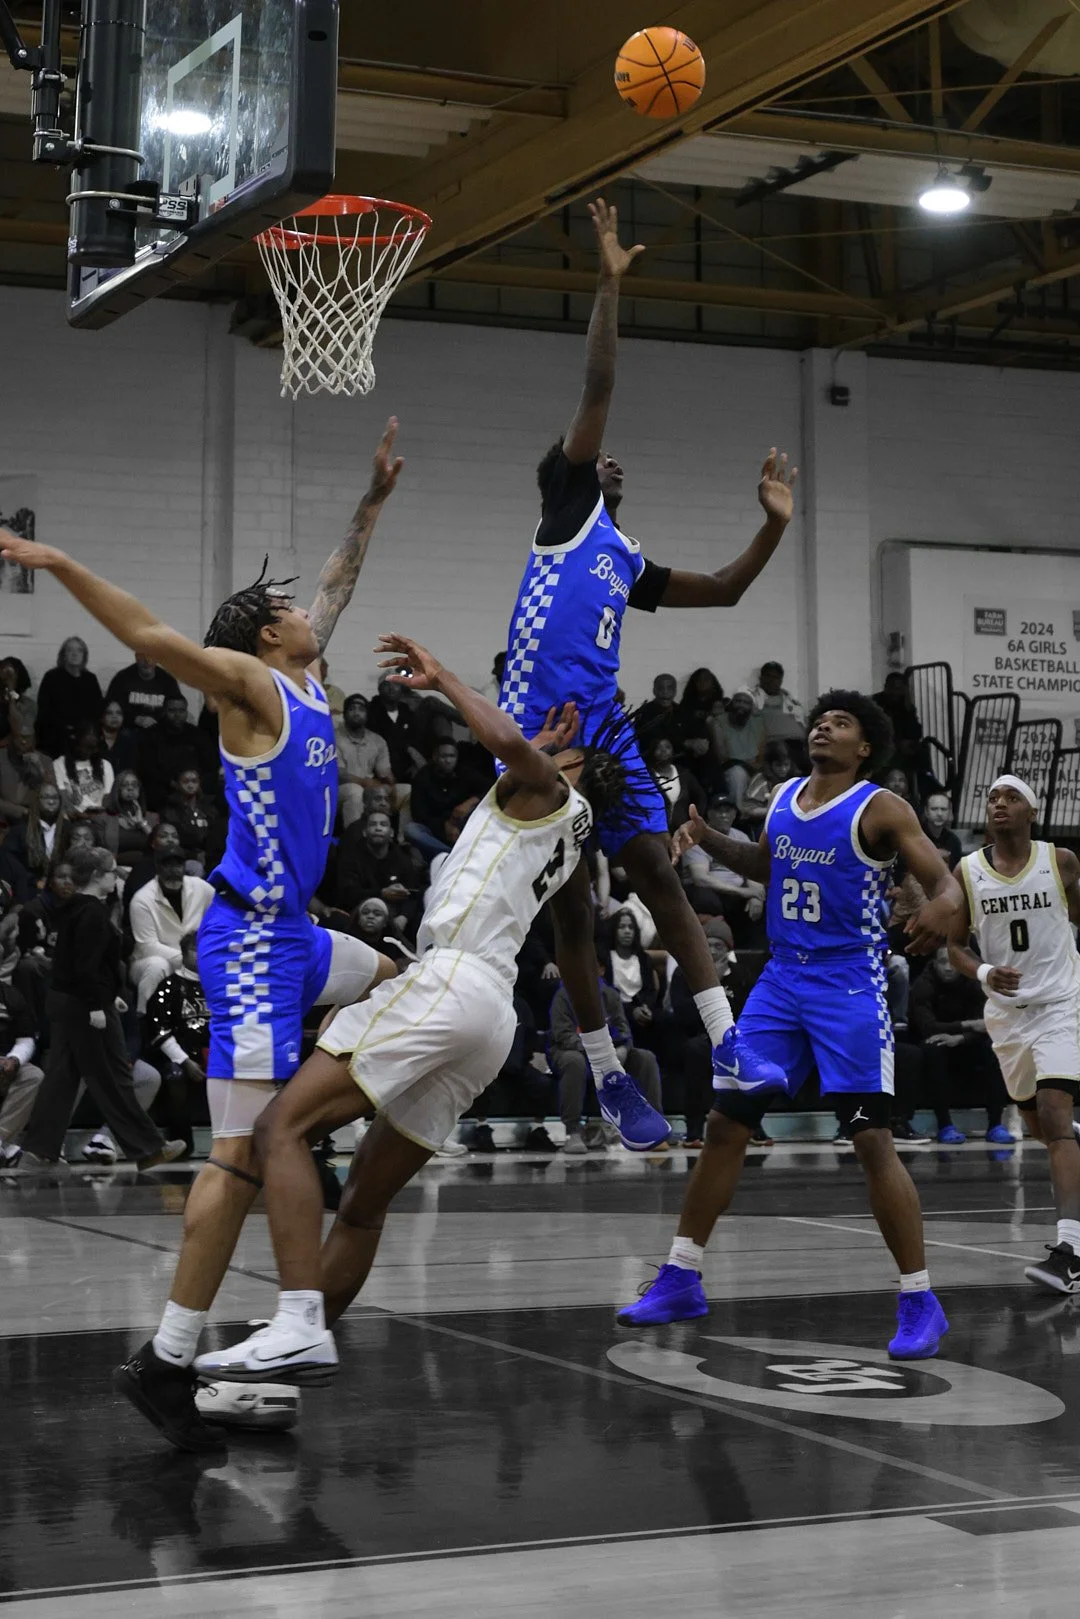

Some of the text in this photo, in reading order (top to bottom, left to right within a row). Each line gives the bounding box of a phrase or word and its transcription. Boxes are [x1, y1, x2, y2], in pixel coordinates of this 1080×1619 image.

[1020, 621, 1054, 636] 2024
[1007, 639, 1068, 655] 6A GIRLS
[994, 656, 1080, 674] BASKETBALL
[972, 674, 1014, 690] STATE
[774, 834, 836, 870] Bryant
[781, 878, 821, 923] 23
[981, 891, 1052, 915] CENTRAL
[1010, 919, 1030, 952] 0
